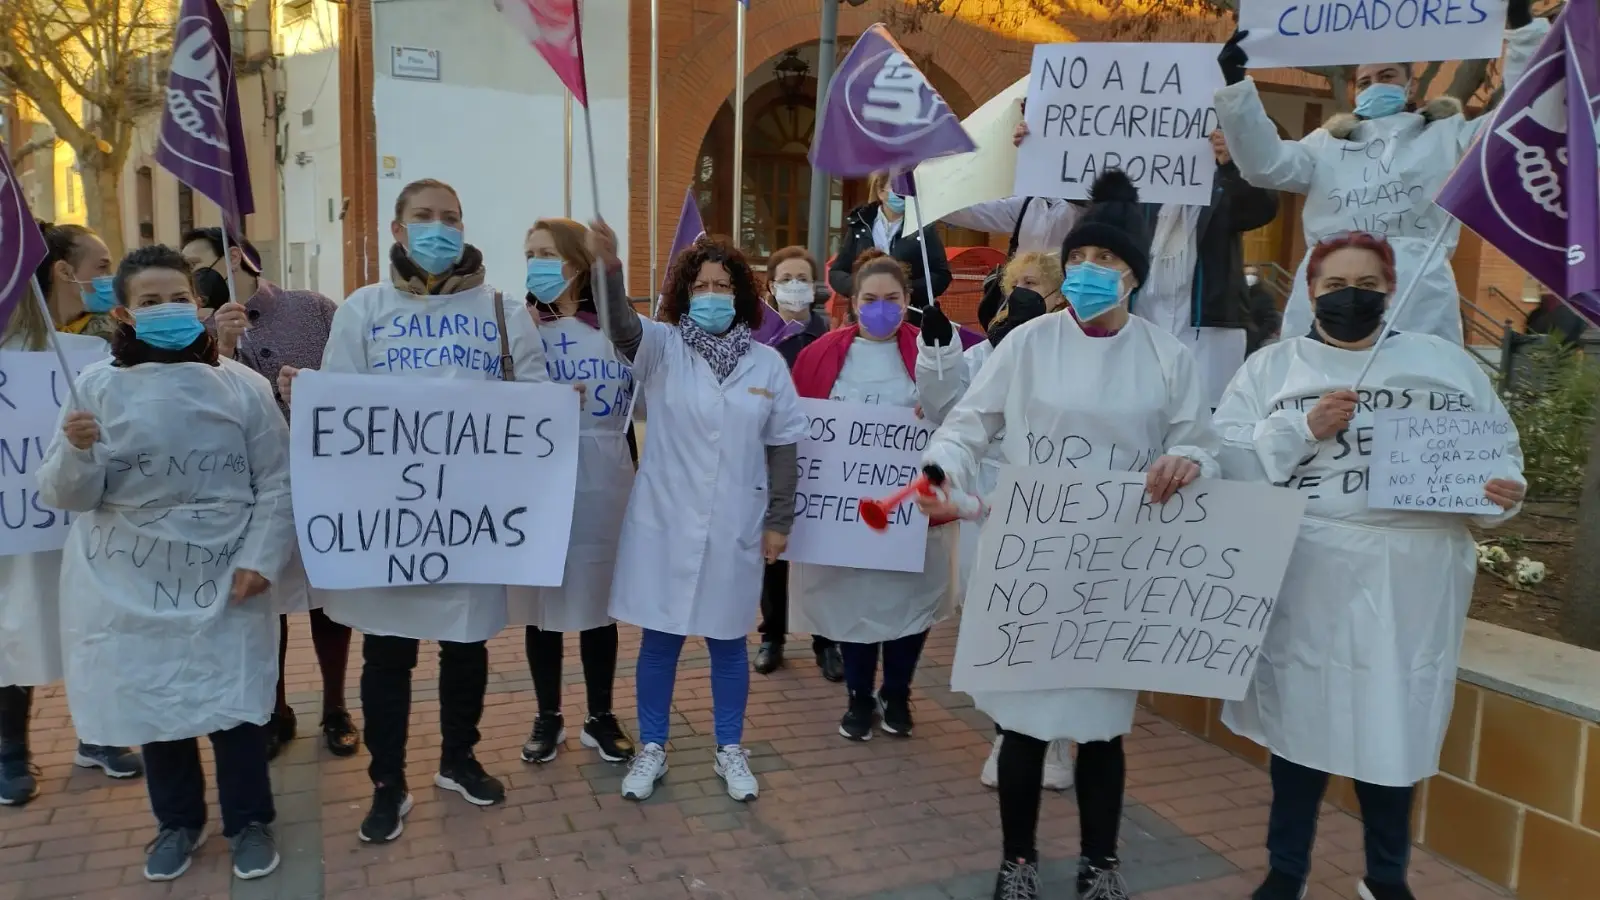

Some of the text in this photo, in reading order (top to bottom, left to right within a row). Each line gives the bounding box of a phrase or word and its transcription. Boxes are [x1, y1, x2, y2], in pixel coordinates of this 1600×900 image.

[1278, 0, 1488, 36] CUIDADORES
[1040, 57, 1182, 95] NO A LA
[1043, 104, 1221, 138] PRECARIEDAD
[312, 406, 555, 458] ESENCIALES
[1387, 416, 1508, 441] TRABAJAMOS
[1427, 438, 1459, 450] CON
[1026, 431, 1092, 469] POR
[1390, 446, 1504, 464] EL CORAZON
[396, 463, 446, 502] SI
[796, 456, 822, 480] SE
[1389, 471, 1493, 487] NOS NIEGAN
[1433, 464, 1443, 474] Y
[1005, 480, 1208, 524] NUESTROS
[1393, 495, 1502, 508] NEGOCIACIO
[1430, 484, 1450, 494] LA
[307, 505, 527, 554] OLVIDADAS
[388, 552, 449, 583] NO
[994, 533, 1242, 580] DERECHOS
[153, 577, 217, 609] NO
[988, 579, 1048, 616] NO
[973, 619, 1261, 676] SE DEFIENDEN
